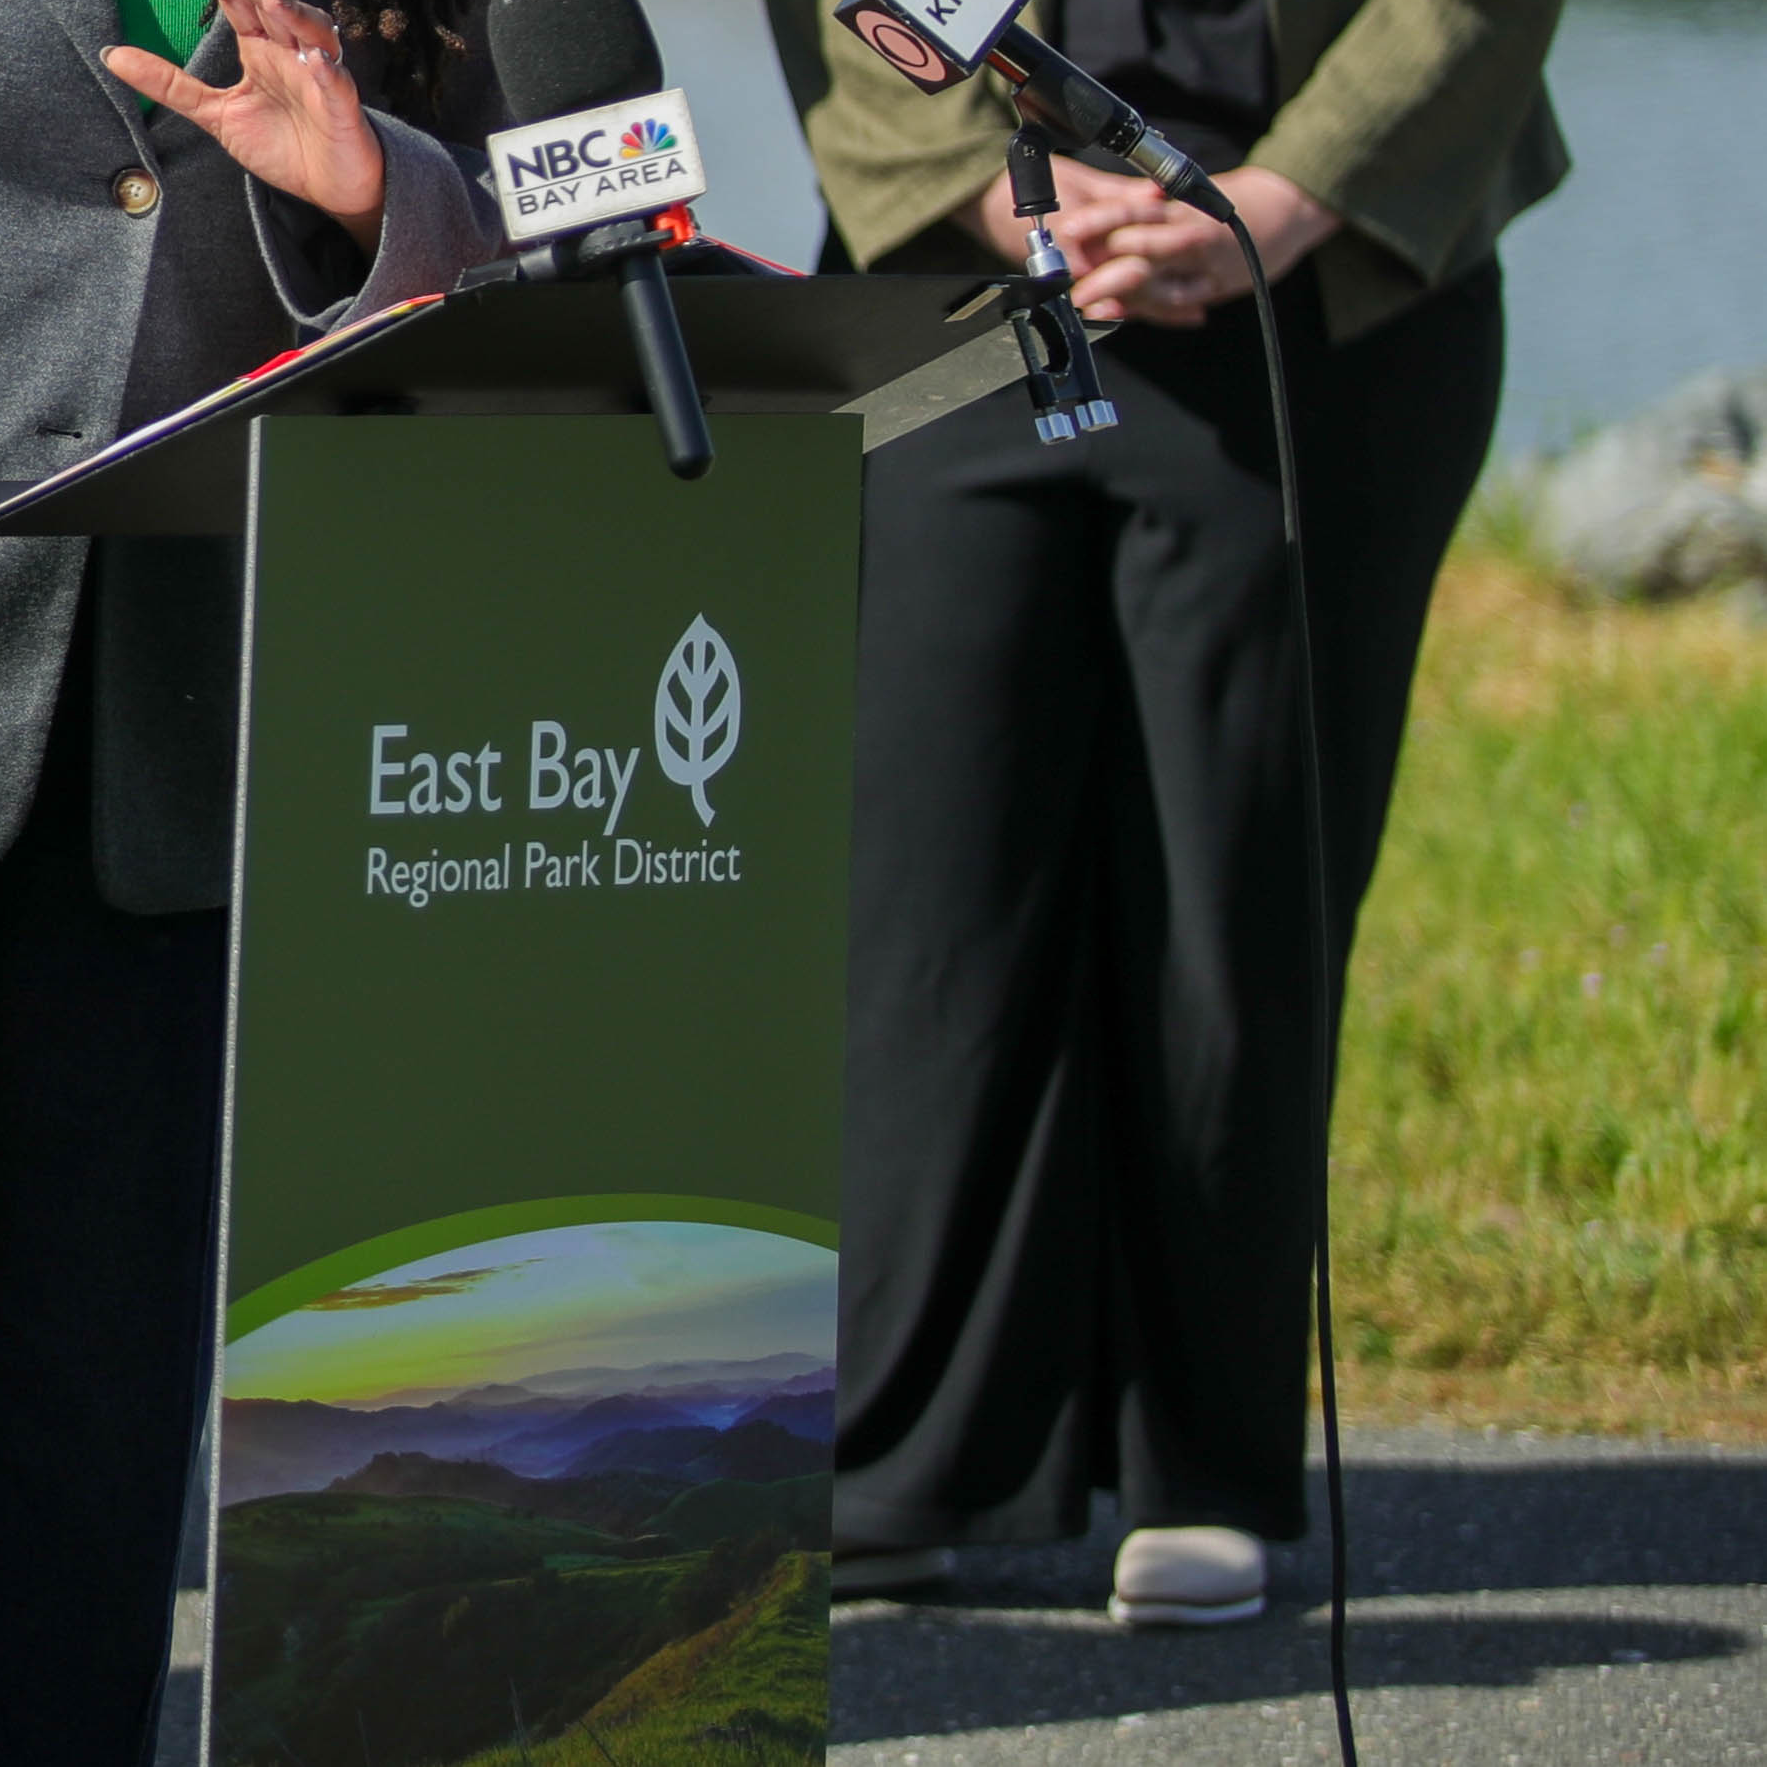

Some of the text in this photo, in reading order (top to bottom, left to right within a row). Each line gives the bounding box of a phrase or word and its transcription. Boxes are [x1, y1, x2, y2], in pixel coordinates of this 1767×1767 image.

[506, 128, 613, 190] NBC
[517, 156, 688, 217] BAY AREA
[369, 720, 641, 836] East Bay
[366, 838, 742, 909] Regional Park District
